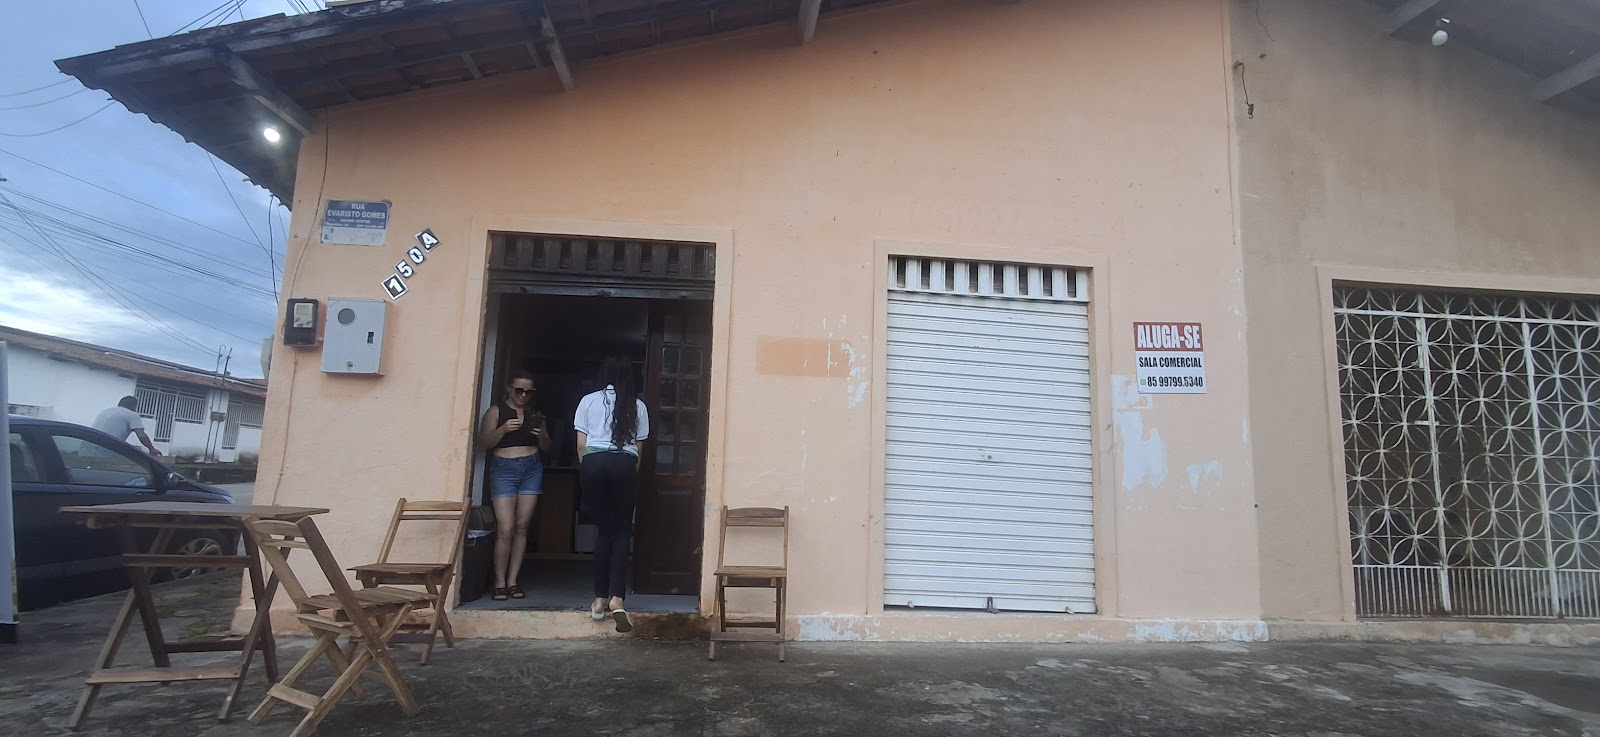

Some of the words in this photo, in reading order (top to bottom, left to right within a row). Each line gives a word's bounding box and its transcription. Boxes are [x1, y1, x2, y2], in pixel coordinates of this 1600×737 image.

[327, 210, 360, 218] EVARISTO
[361, 211, 386, 219] GOMES
[388, 232, 438, 293] 150A
[1137, 324, 1201, 349] ALUGA-SE
[1138, 356, 1158, 368] SALA
[1159, 356, 1202, 368] COMERCIAL
[1147, 376, 1158, 387] 85
[1158, 376, 1204, 387] 99799.5340
